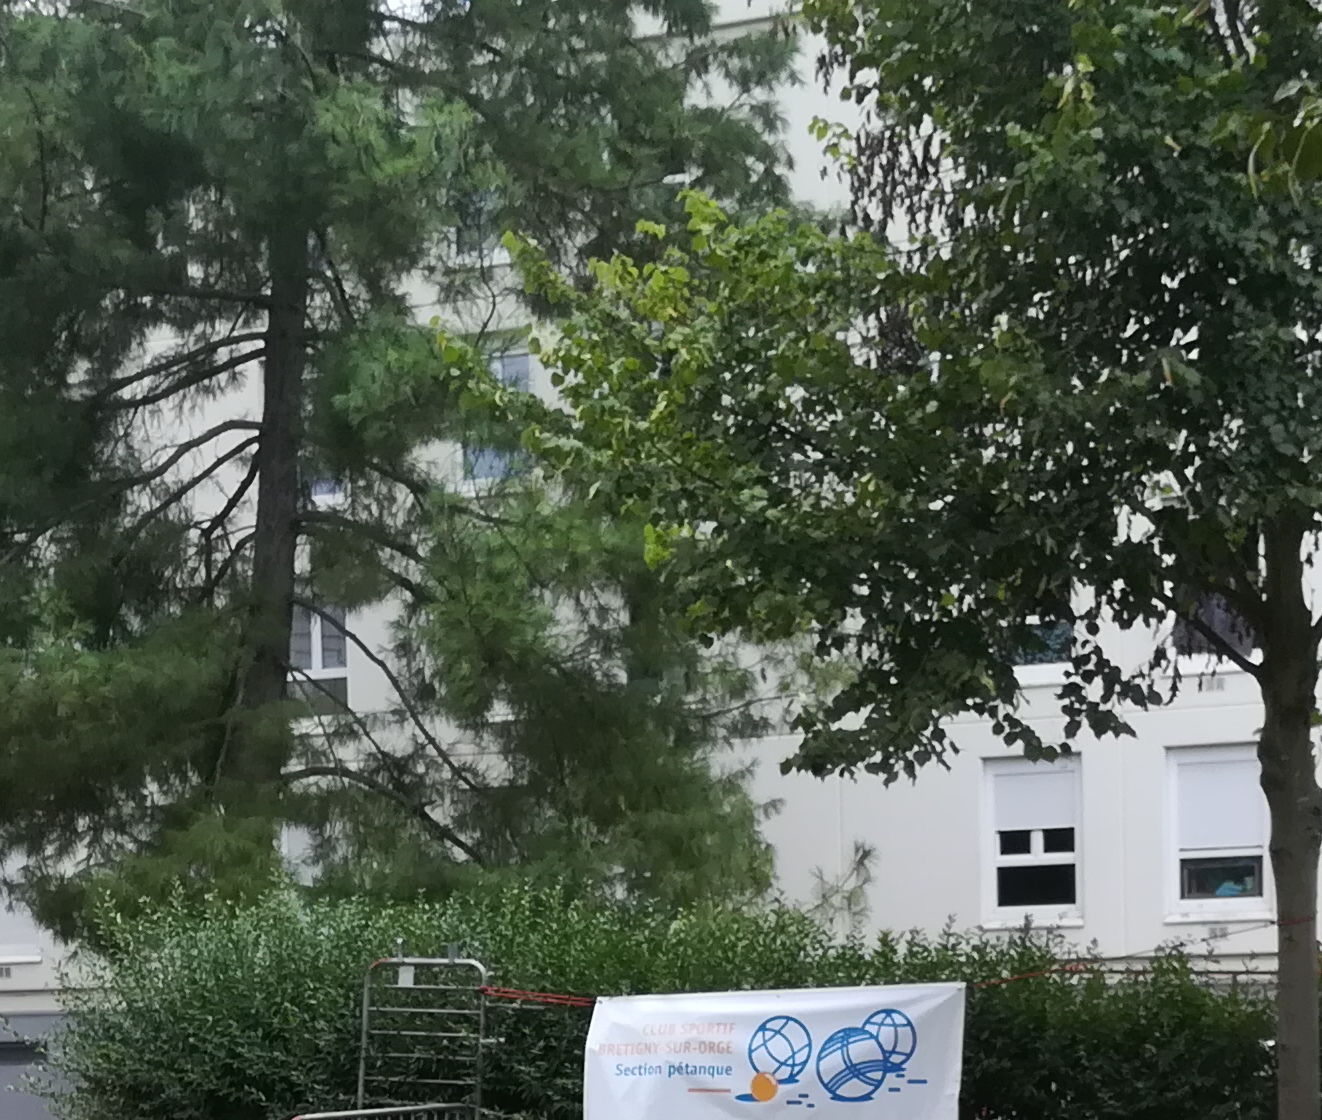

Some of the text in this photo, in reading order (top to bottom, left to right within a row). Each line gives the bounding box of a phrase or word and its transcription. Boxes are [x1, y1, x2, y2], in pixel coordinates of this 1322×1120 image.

[642, 1022, 736, 1036] CLUB SPORTIF
[614, 1061, 733, 1078] Section pétanque
